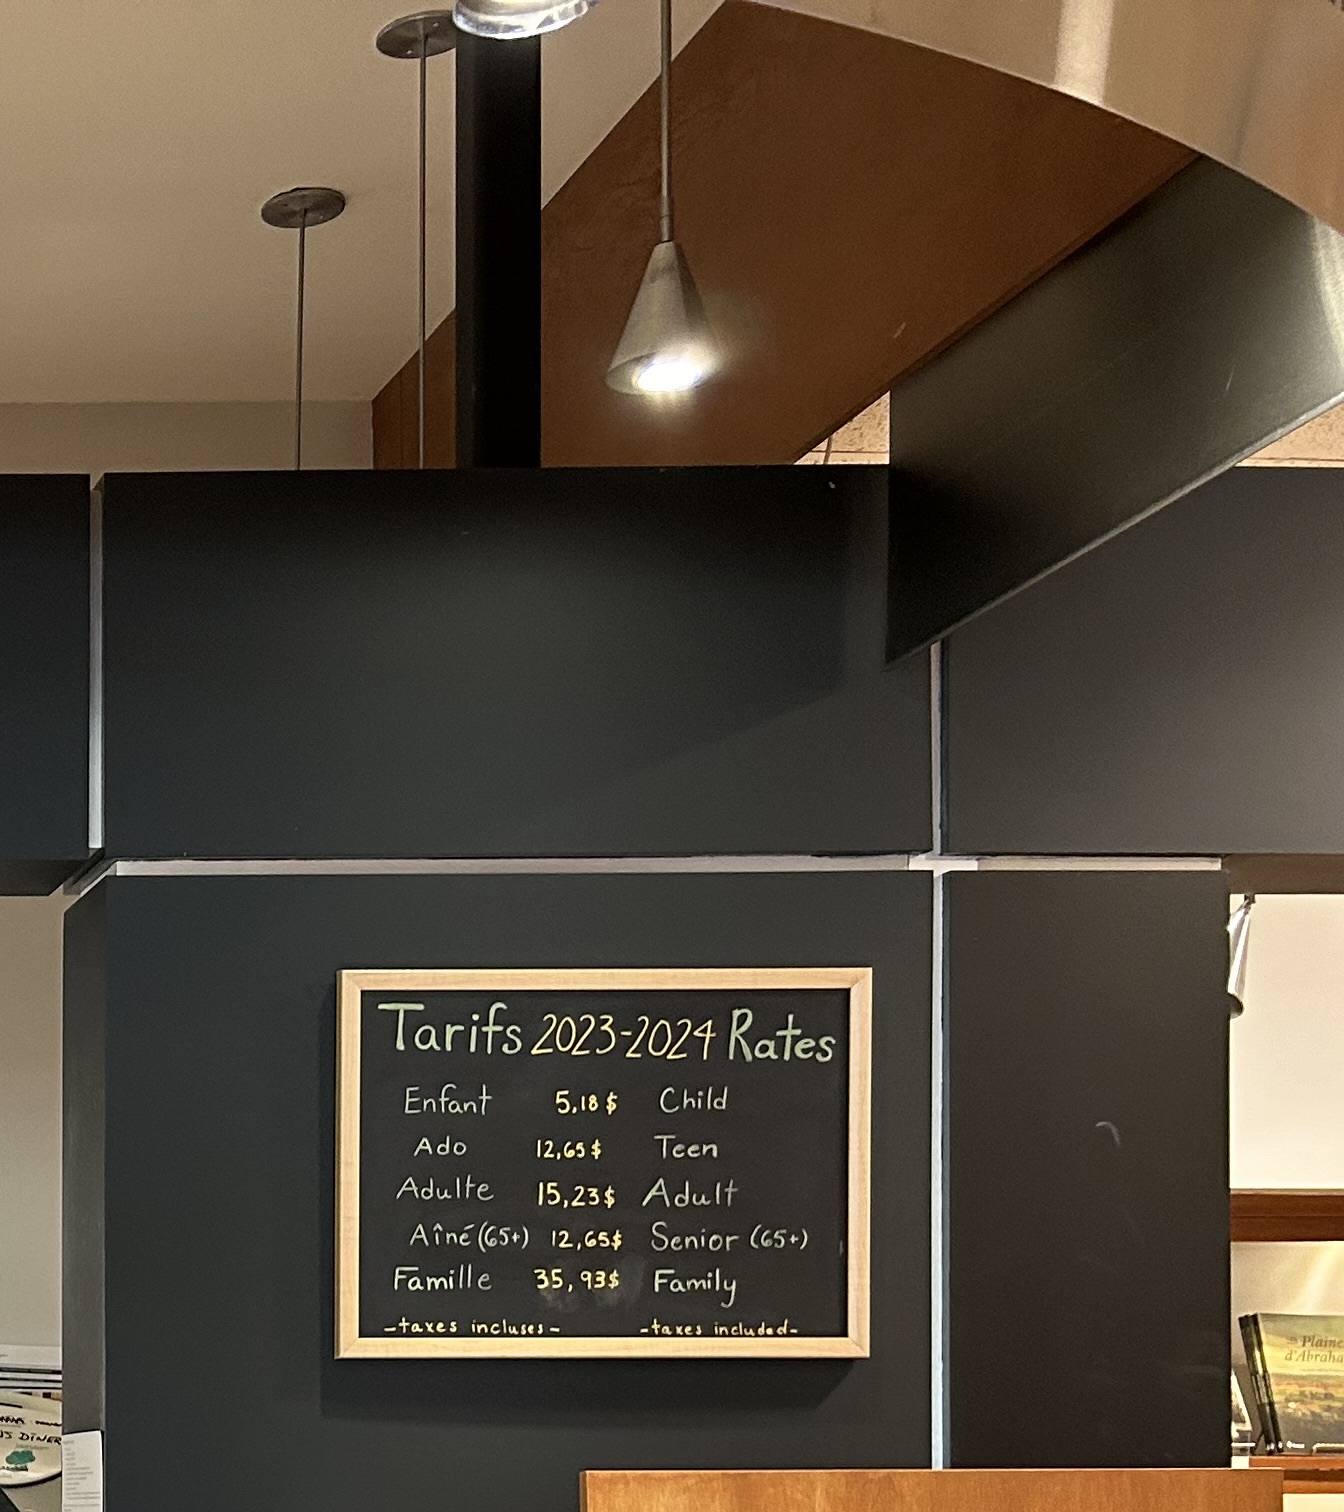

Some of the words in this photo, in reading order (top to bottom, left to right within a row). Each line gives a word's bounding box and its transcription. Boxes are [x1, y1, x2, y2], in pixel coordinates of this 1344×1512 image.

[378, 1002, 522, 1054] Tarifs
[531, 1014, 716, 1060] 2023-2024
[729, 1009, 836, 1062] Rates
[405, 1084, 492, 1115] Enfant
[660, 1086, 728, 1113] Child
[414, 1137, 466, 1156] Ado
[654, 1135, 717, 1158] Teen
[396, 1177, 494, 1200] Adulte
[538, 1182, 615, 1208] 15,23$
[642, 1178, 738, 1207] Adult
[552, 1230, 622, 1251] 12,65$
[651, 1222, 739, 1251] Senior
[751, 1224, 808, 1249] (65+)
[394, 1265, 491, 1291] Famille
[655, 1268, 736, 1308] Family
